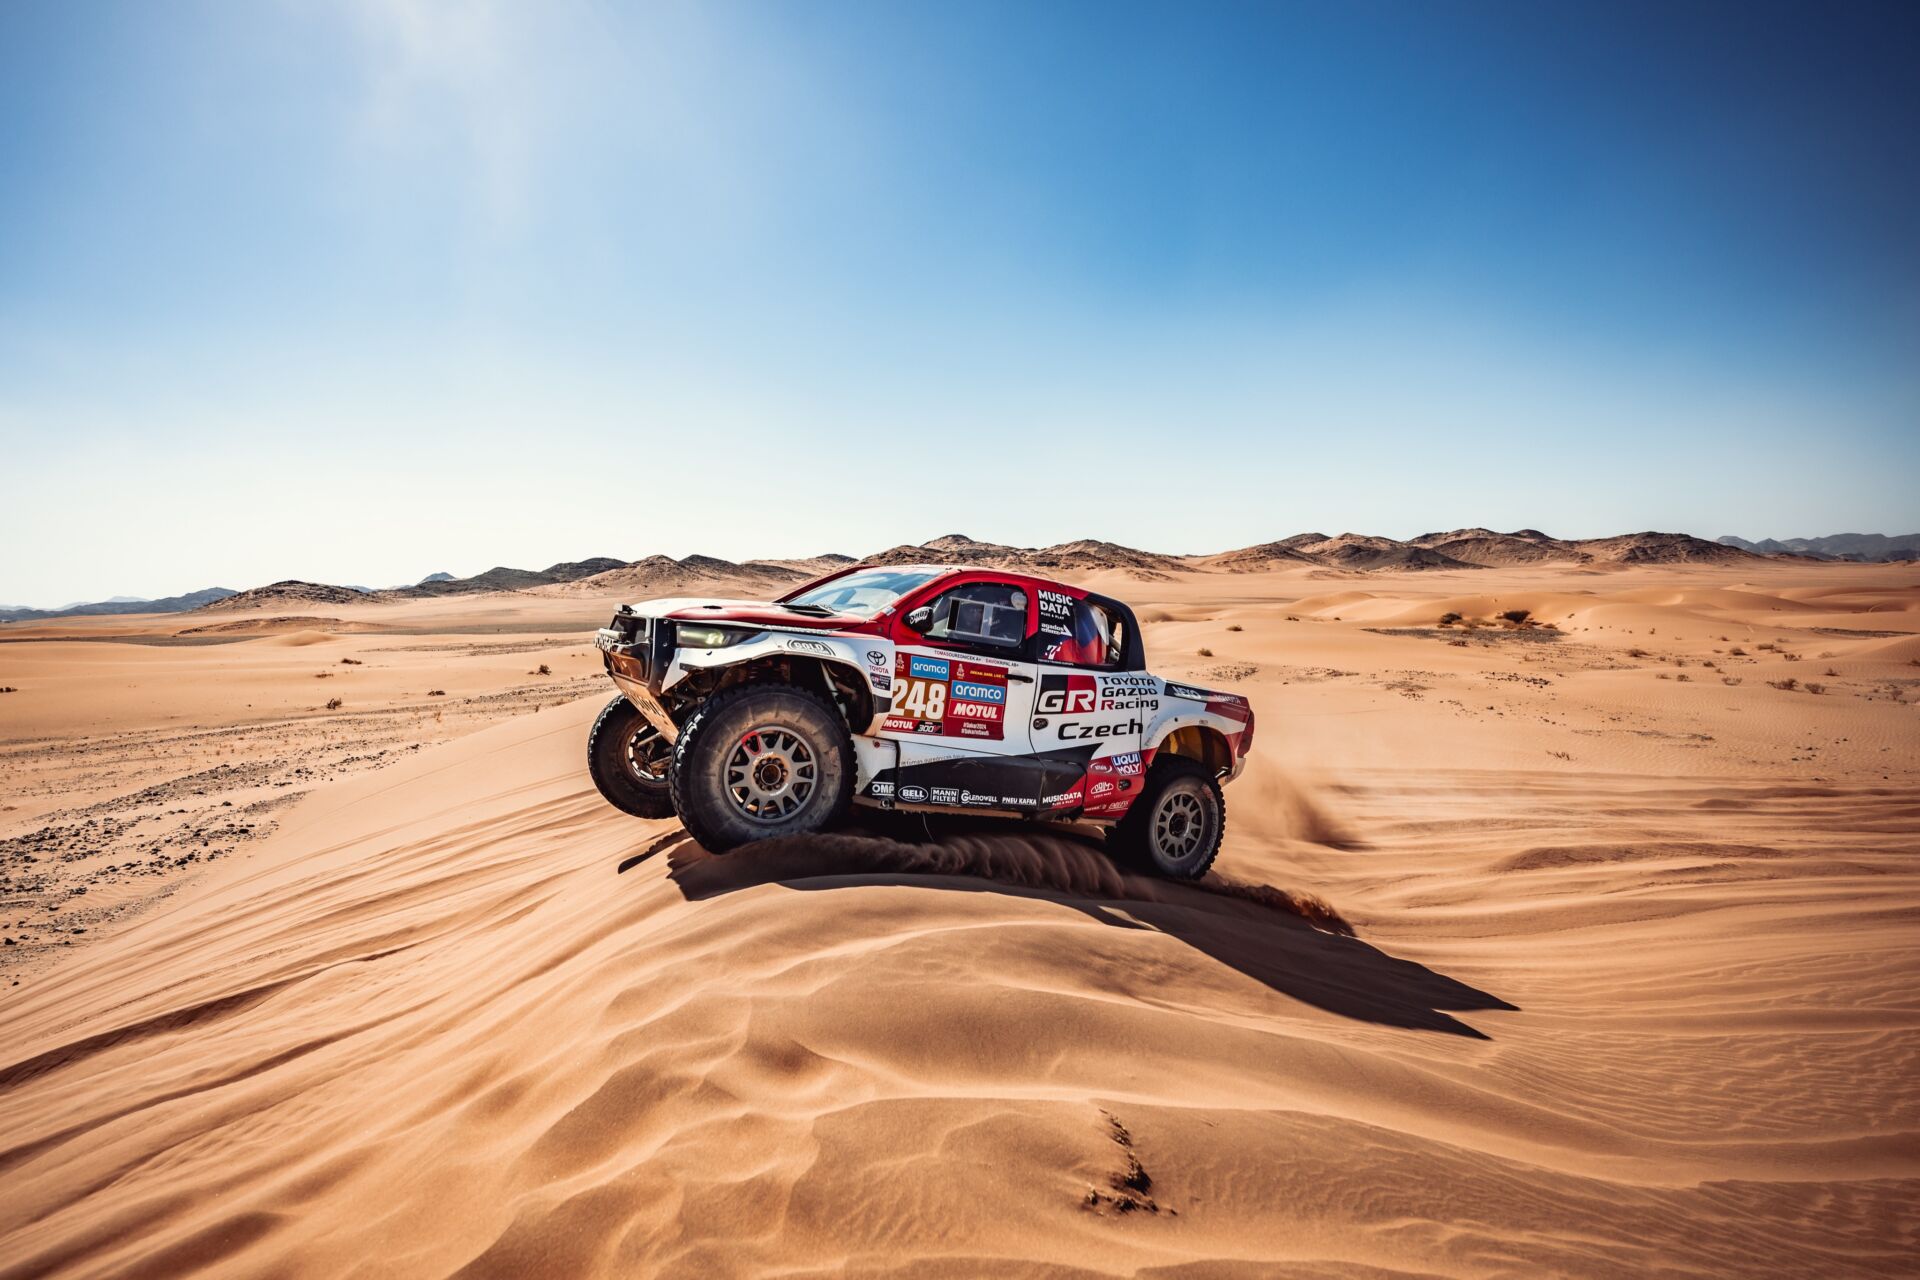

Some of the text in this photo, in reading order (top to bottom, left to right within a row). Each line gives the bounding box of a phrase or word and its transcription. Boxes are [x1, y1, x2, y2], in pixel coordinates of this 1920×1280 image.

[1038, 589, 1073, 606] MUSIC
[1040, 600, 1070, 616] DATA
[869, 665, 889, 674] TOYOTA
[913, 662, 947, 674] aramco
[1099, 676, 1156, 687] TOYOTA
[955, 684, 1002, 699] aramco
[1102, 687, 1158, 698] GAZOO
[889, 678, 947, 720] 248
[1038, 689, 1095, 713] GR
[1101, 698, 1159, 711] Racing
[953, 703, 998, 719] MOTUL
[883, 718, 914, 730] MOTUL
[1058, 718, 1144, 740] Czech
[1113, 753, 1139, 766] LIQUI
[1117, 763, 1140, 774] MOLY
[872, 785, 894, 794] OMP
[902, 789, 924, 798] BELL
[932, 795, 957, 803] FILTER
[1019, 798, 1037, 806] KAFKA
[1043, 792, 1081, 804] MUSICDATA
